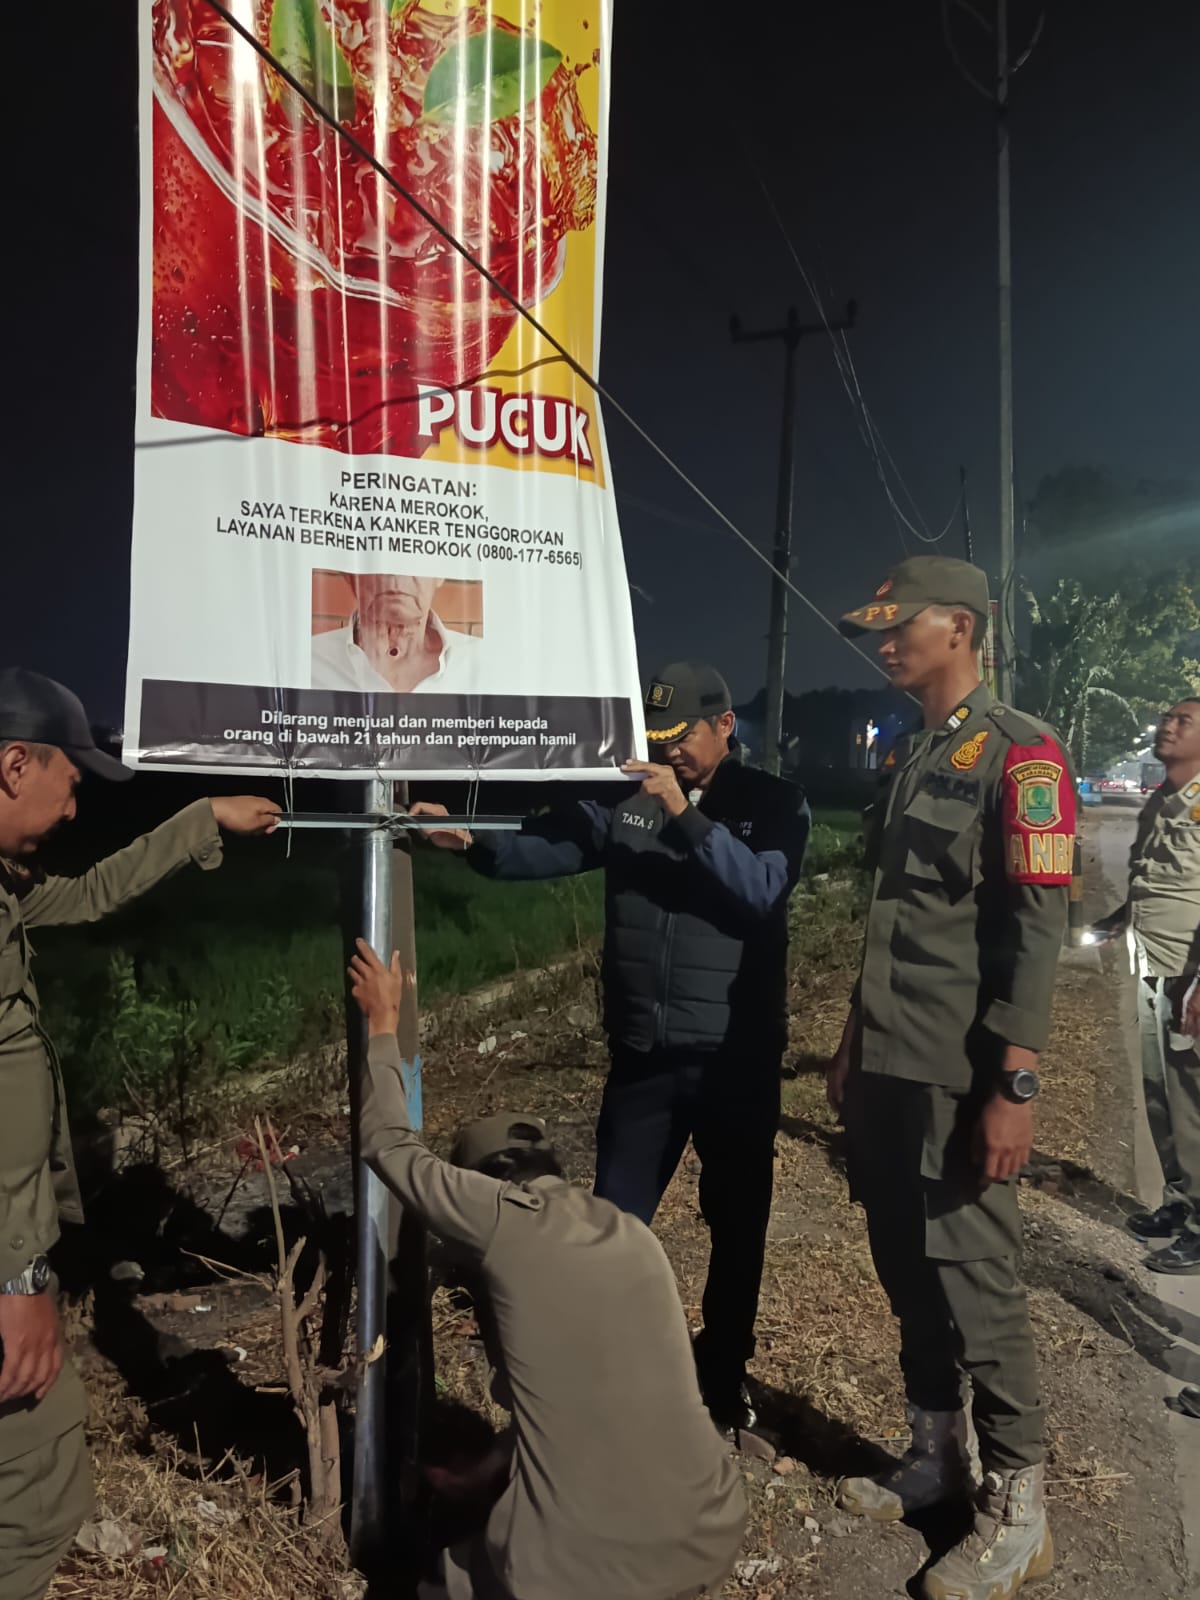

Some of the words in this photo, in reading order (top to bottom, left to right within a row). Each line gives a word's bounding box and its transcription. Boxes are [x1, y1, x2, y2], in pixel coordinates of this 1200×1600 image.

[417, 384, 592, 461] PUCUK
[341, 471, 477, 498] PERINGATAN:
[330, 491, 396, 513] KARENA
[401, 499, 489, 522] MEROKOK,
[240, 500, 286, 520] SAYA
[289, 506, 366, 532] TERKENA
[370, 515, 440, 536] KANKER
[445, 522, 564, 546] TENGGOROKAN
[216, 516, 295, 542] LAYANAN
[300, 528, 383, 551] BERHENTI
[388, 535, 472, 558] MEROKOK
[477, 543, 583, 570] (0800-177-6565)
[261, 710, 328, 729] Dilarang
[333, 715, 394, 731] menjual
[398, 715, 427, 729] dan
[431, 716, 495, 729] memberi
[498, 716, 548, 732] kepada
[223, 729, 273, 745] orang
[278, 729, 292, 743] di
[297, 730, 350, 744] bawah
[354, 732, 370, 745] 21
[376, 732, 421, 745] tahun
[425, 732, 453, 745] dan
[457, 734, 536, 748] perempuan
[540, 733, 576, 745] hamil
[622, 812, 645, 828] TATA
